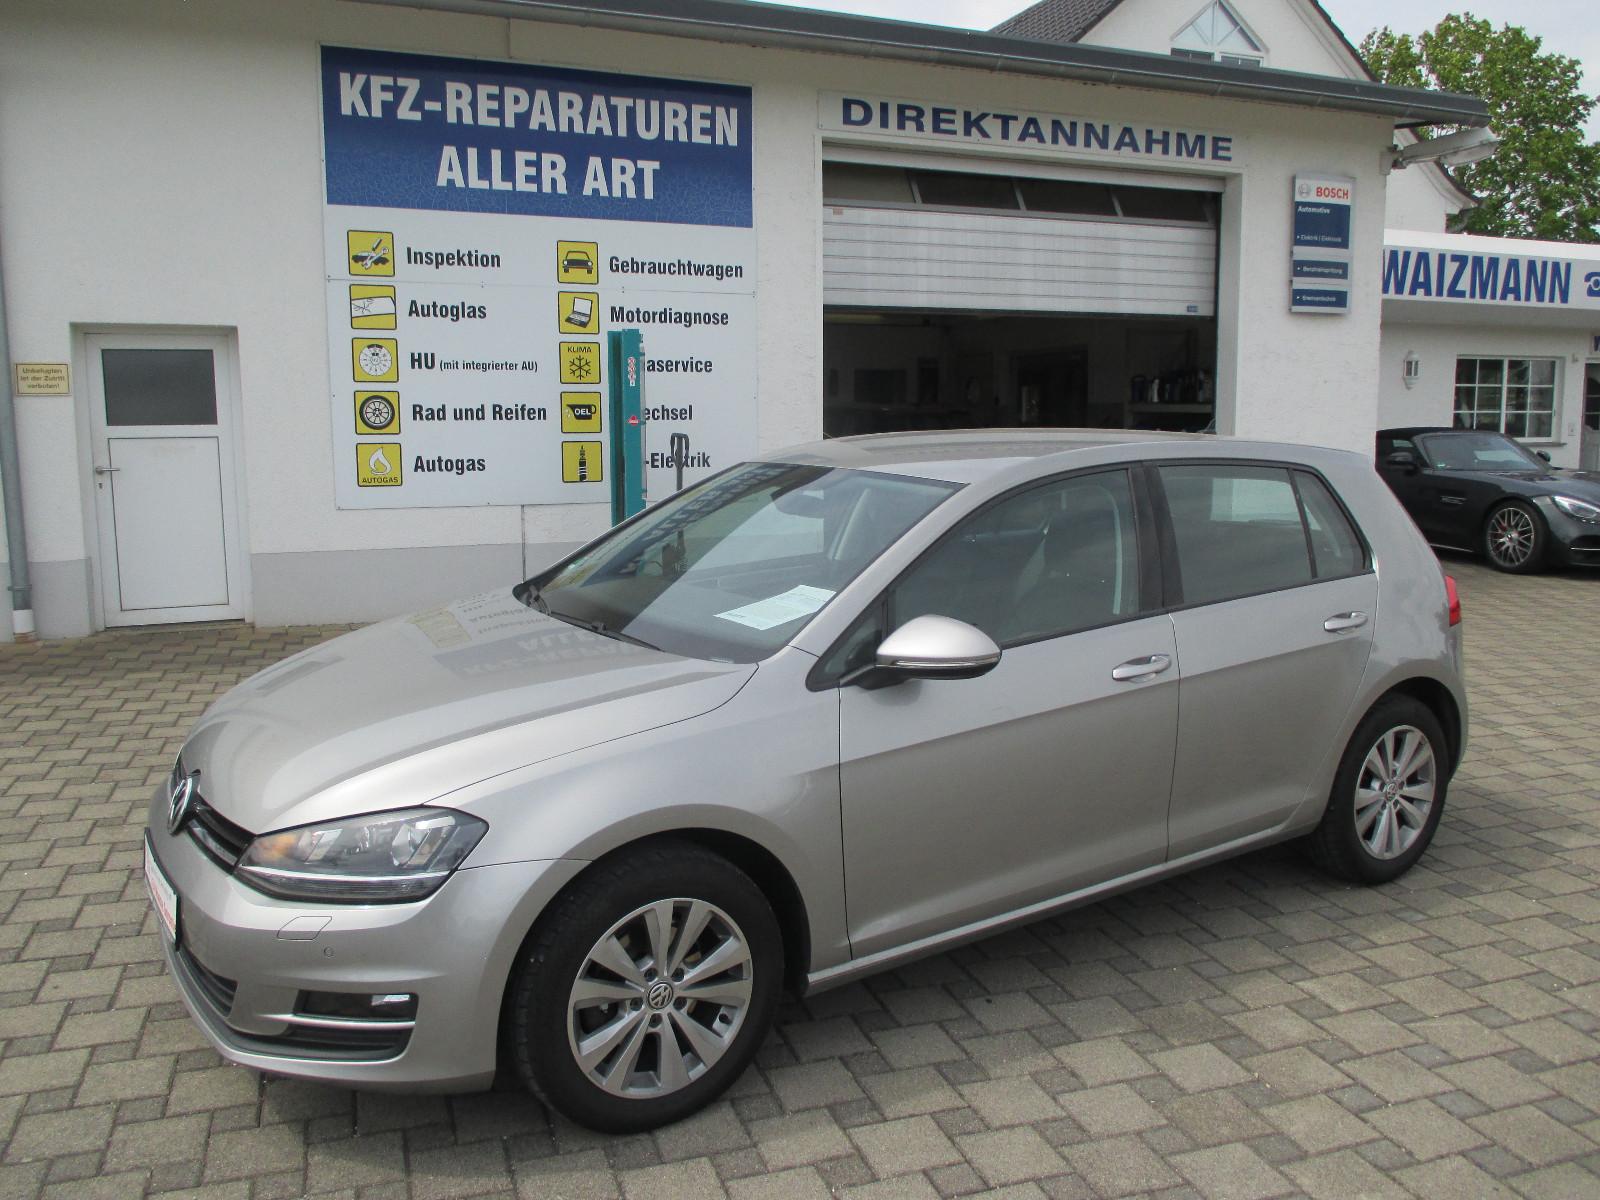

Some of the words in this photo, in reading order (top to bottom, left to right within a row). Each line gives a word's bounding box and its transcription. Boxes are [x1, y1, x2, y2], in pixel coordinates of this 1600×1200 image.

[339, 72, 739, 146] KFZ-REPARATUREN
[842, 98, 1233, 161] DIREKTANNAHME
[436, 145, 567, 195] ALLER
[582, 156, 661, 200] ART
[1316, 187, 1349, 199] BOSCH
[407, 247, 501, 271] Inspektion
[609, 256, 744, 280] Gebrauchtwagen
[1382, 249, 1572, 304] WAIZMANN
[408, 300, 487, 321] Autoglas
[610, 307, 729, 328] Motordiagnose
[410, 353, 435, 370] HU
[439, 360, 459, 373] (mit
[462, 359, 519, 374] integrierter
[521, 360, 538, 373] AU)
[644, 356, 713, 373] aservice
[412, 404, 446, 422] Rad
[453, 404, 486, 422] und
[492, 403, 548, 422] Reifen
[574, 408, 591, 416] OEL
[644, 404, 693, 421] echsel
[414, 455, 486, 475] Autogas
[361, 476, 399, 485] AUTOGAS
